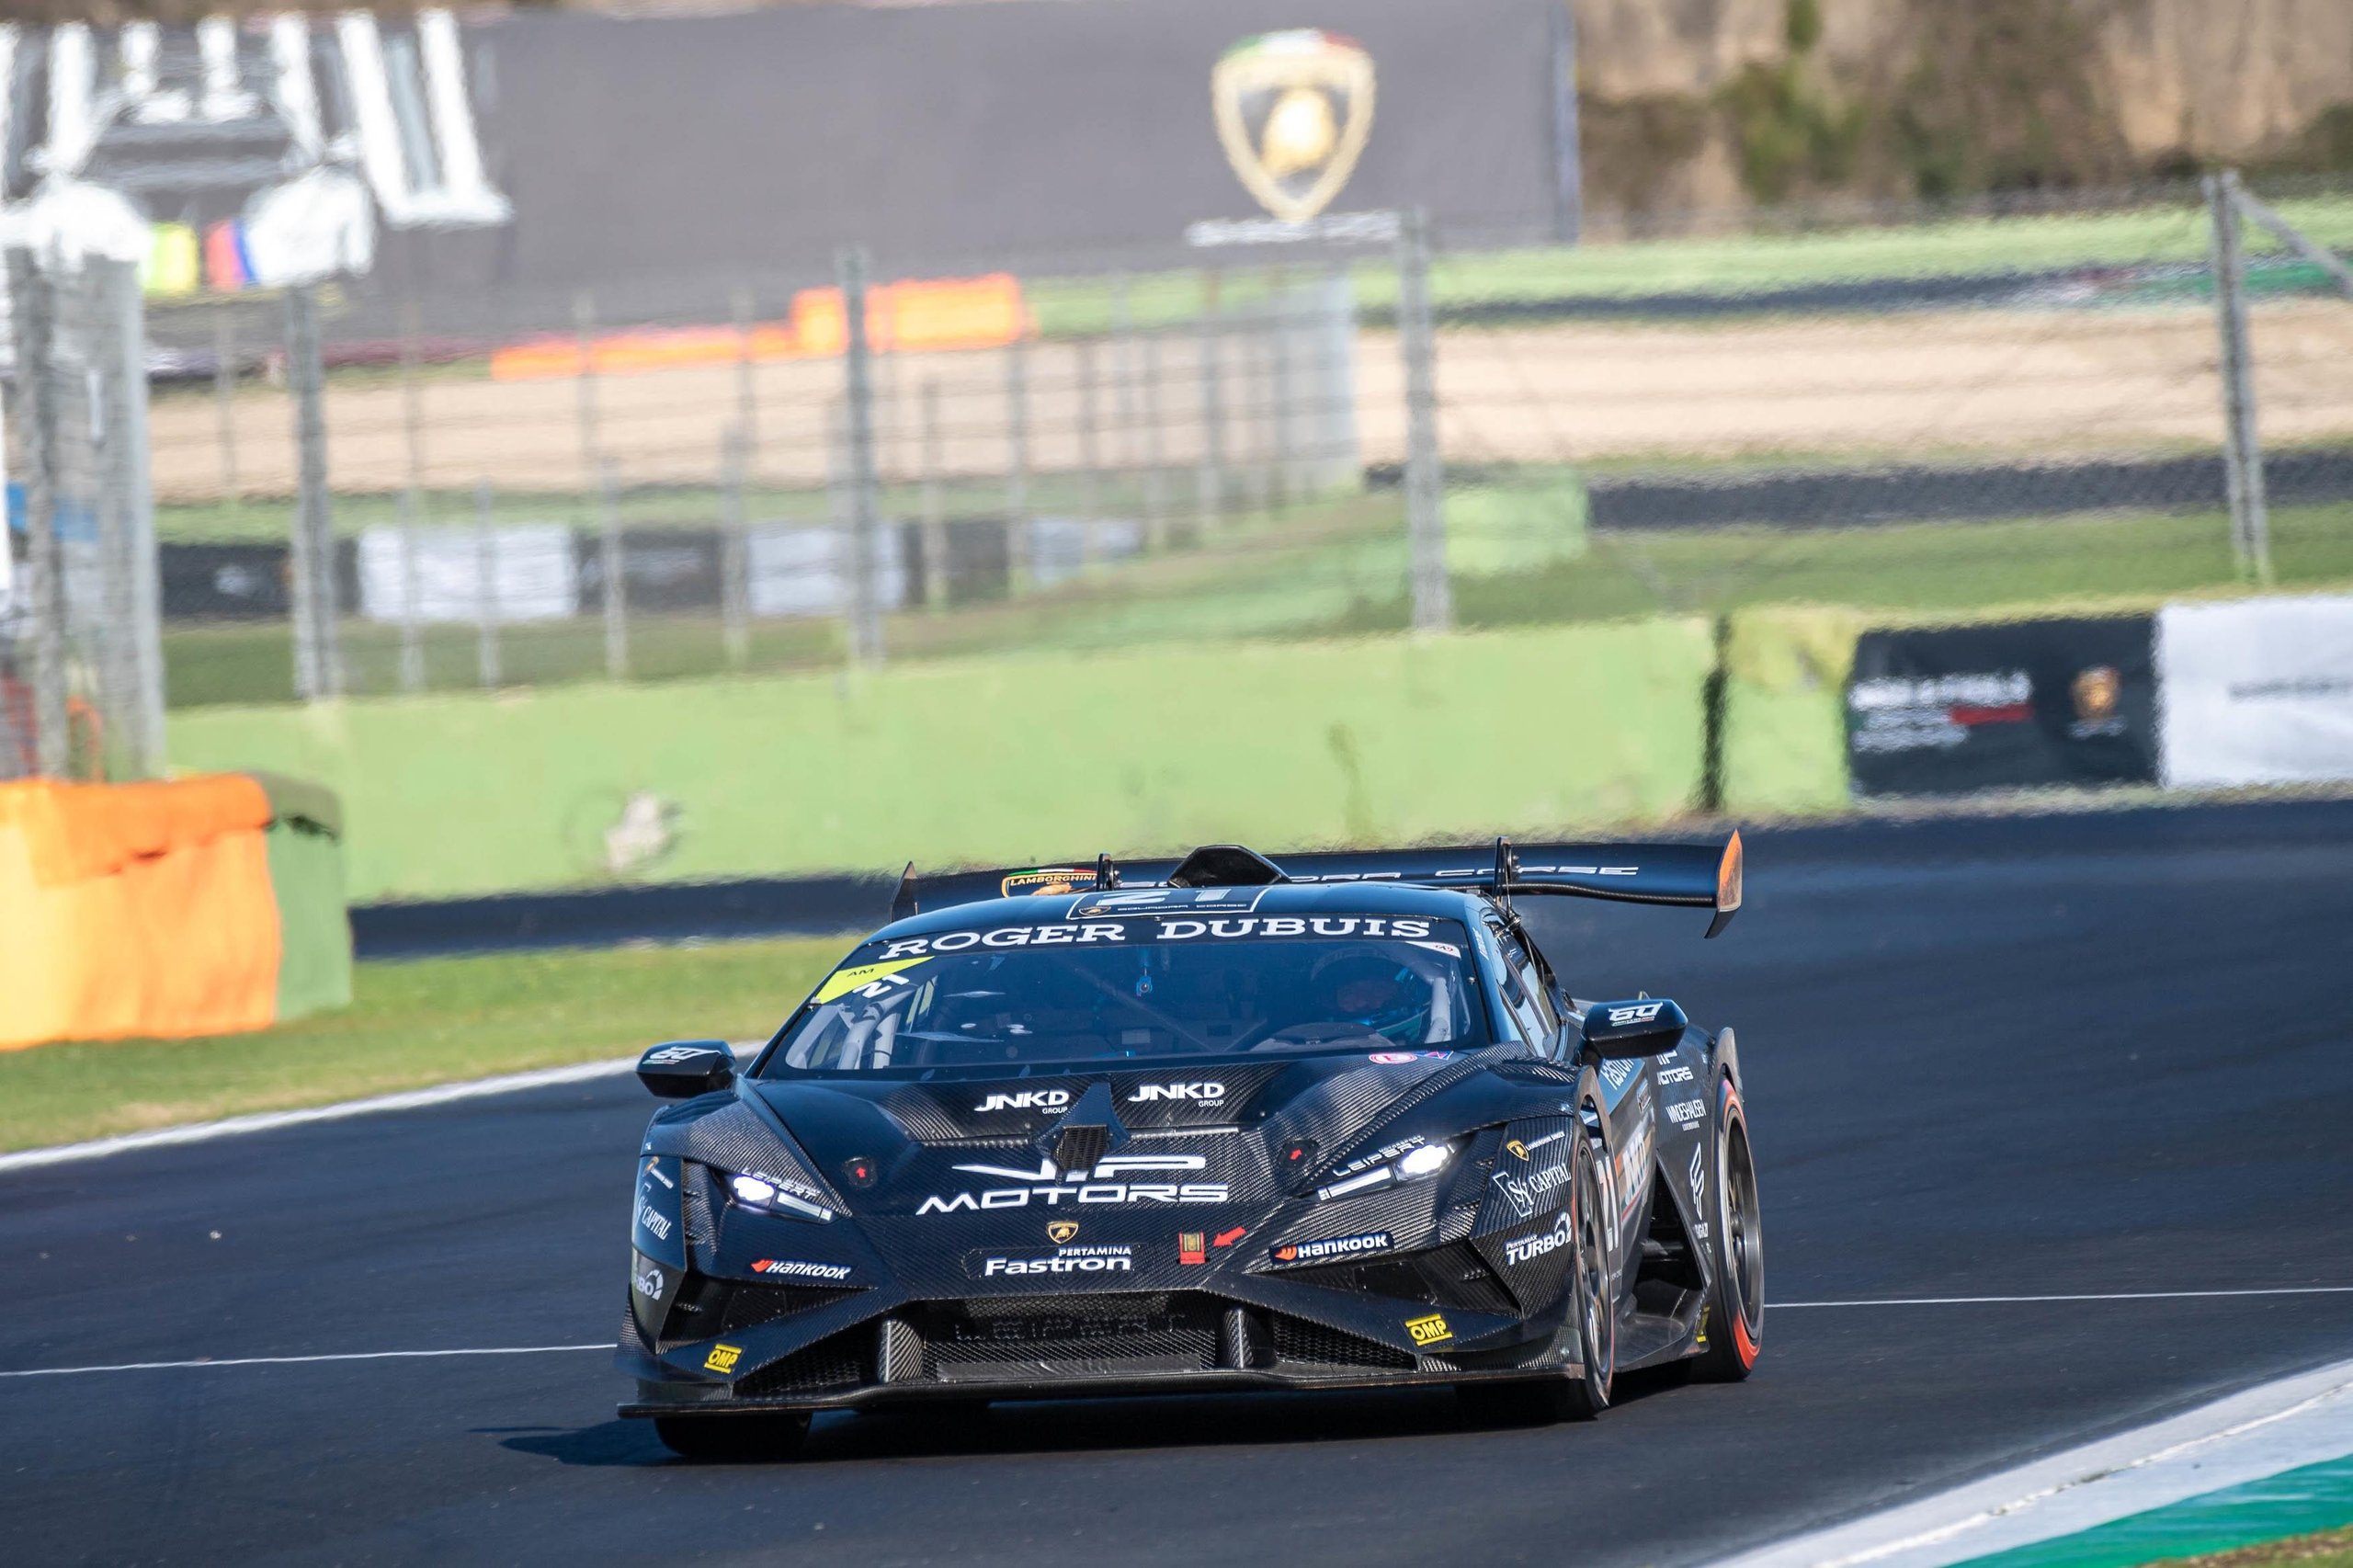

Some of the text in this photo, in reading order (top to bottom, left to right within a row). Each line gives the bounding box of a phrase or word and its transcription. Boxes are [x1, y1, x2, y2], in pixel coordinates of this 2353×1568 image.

[1010, 874, 1097, 886] LAMBORGHINI
[879, 917, 1430, 960] ROGER DUBUIS
[973, 1090, 1070, 1112] JNKD
[1127, 1083, 1225, 1102] JNKD
[1041, 1107, 1069, 1115] GROUP
[1198, 1099, 1225, 1108] GROUP
[1333, 1137, 1426, 1176] LEIPERT
[1529, 1163, 1572, 1193] CAPITAL
[915, 1184, 1229, 1216] MOTORS
[642, 1206, 672, 1241] CAPITAL
[1058, 1246, 1132, 1257] PERTAMINA
[1506, 1229, 1566, 1267] TURBO
[984, 1257, 1132, 1277] Fastron
[1410, 1320, 1447, 1341] OMP
[708, 1349, 739, 1369] OMP
